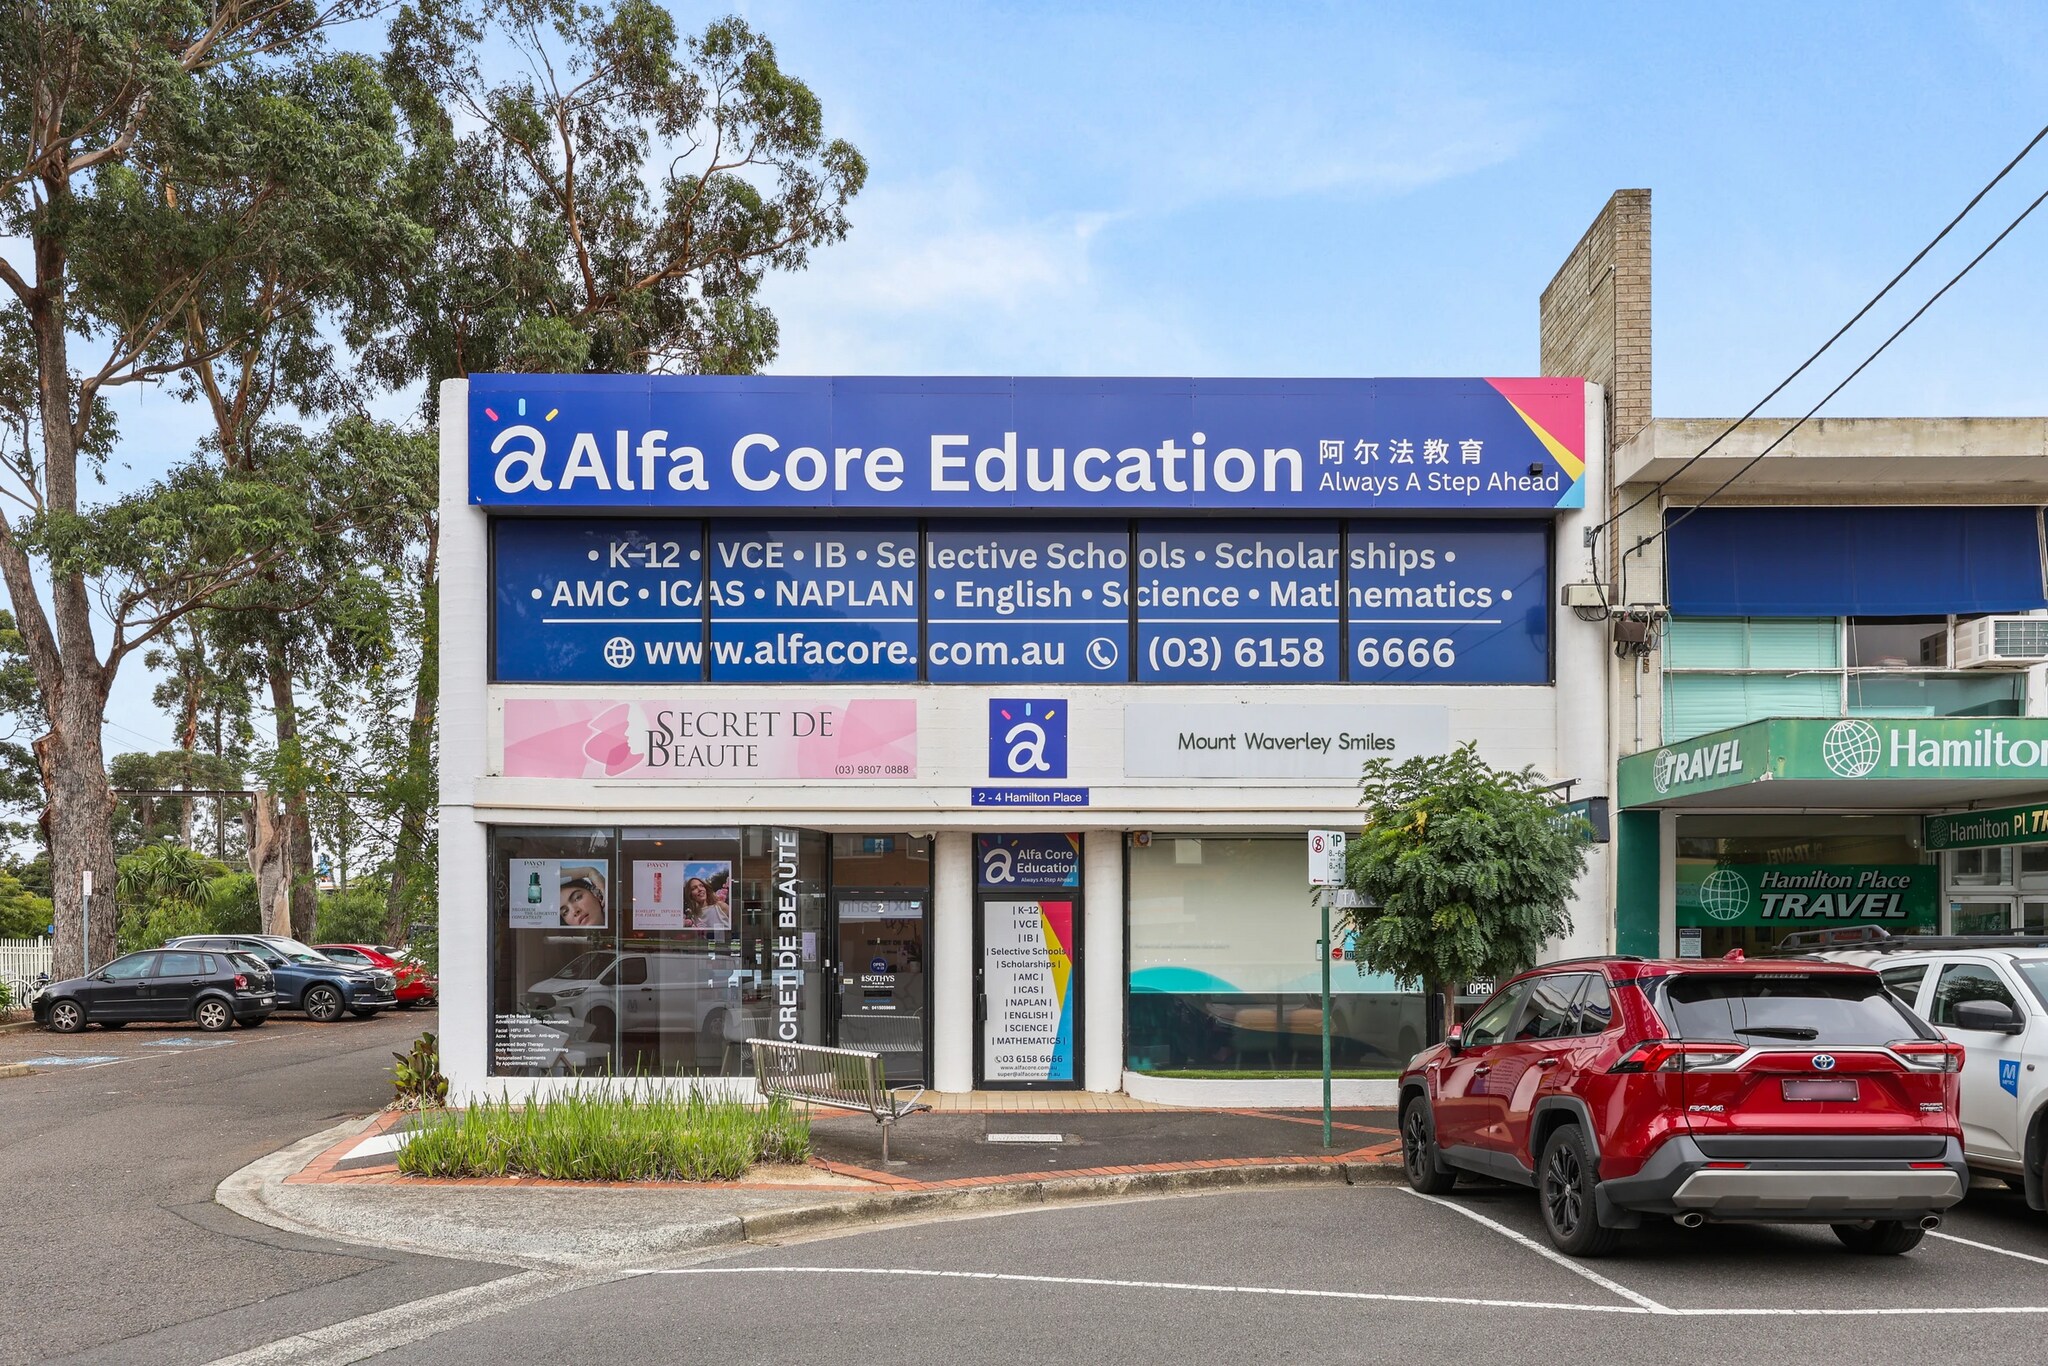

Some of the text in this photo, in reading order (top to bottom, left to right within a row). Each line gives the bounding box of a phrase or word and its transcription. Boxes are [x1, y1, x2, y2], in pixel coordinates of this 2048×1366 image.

[1319, 439, 1484, 465] 阿尔法教育
[559, 430, 708, 491] Alfa
[731, 433, 904, 492] Core
[932, 430, 1303, 492] Education
[1319, 471, 1559, 497] Always A Step Ahead
[718, 541, 784, 568] VCE
[815, 541, 847, 568] IB
[551, 580, 629, 607] AMC
[660, 580, 745, 607] ICAS
[776, 580, 914, 607] NAPLAN
[957, 580, 1072, 614] English
[1102, 580, 1240, 608] Science
[1149, 636, 1222, 672] (03)
[1234, 637, 1324, 668] 6158
[1357, 637, 1456, 668] 6666
[656, 710, 833, 747] SECRET DE
[646, 730, 759, 767] BEAUTE
[1178, 732, 1396, 754] Mount Waverley Smiles
[1664, 739, 1743, 786] TRAVEL
[835, 764, 909, 776] (03) 9807 0888
[978, 792, 986, 802] 2
[995, 792, 1002, 802] 4
[1005, 792, 1050, 803] Hamilton
[1053, 792, 1082, 803] Place
[1950, 817, 2009, 842] Hamilton
[2014, 812, 2029, 836] Pl.
[1331, 834, 1342, 847] 1P
[1018, 849, 1073, 860] Alfa Core
[1017, 863, 1077, 873] Education
[775, 831, 797, 928] BEAUTÉ
[1760, 870, 1911, 889] Hamilton Place
[878, 902, 885, 913] 2
[1760, 893, 1907, 918] TRAVEL
[1019, 920, 1038, 928] VCE
[1023, 934, 1034, 942] IB
[779, 936, 797, 969] DE
[991, 948, 1066, 956] Selective Schools
[1001, 960, 1056, 969] Scholarships
[865, 974, 895, 982] SOTHYS
[1018, 973, 1039, 981] AMC
[1469, 983, 1493, 994] OPEN
[1010, 999, 1047, 1007] NAPLAN
[1010, 1024, 1048, 1032] SCIENCE
[997, 1037, 1061, 1045] MATHEMATICS
[1002, 1055, 1063, 1063] 03 6158 6666
